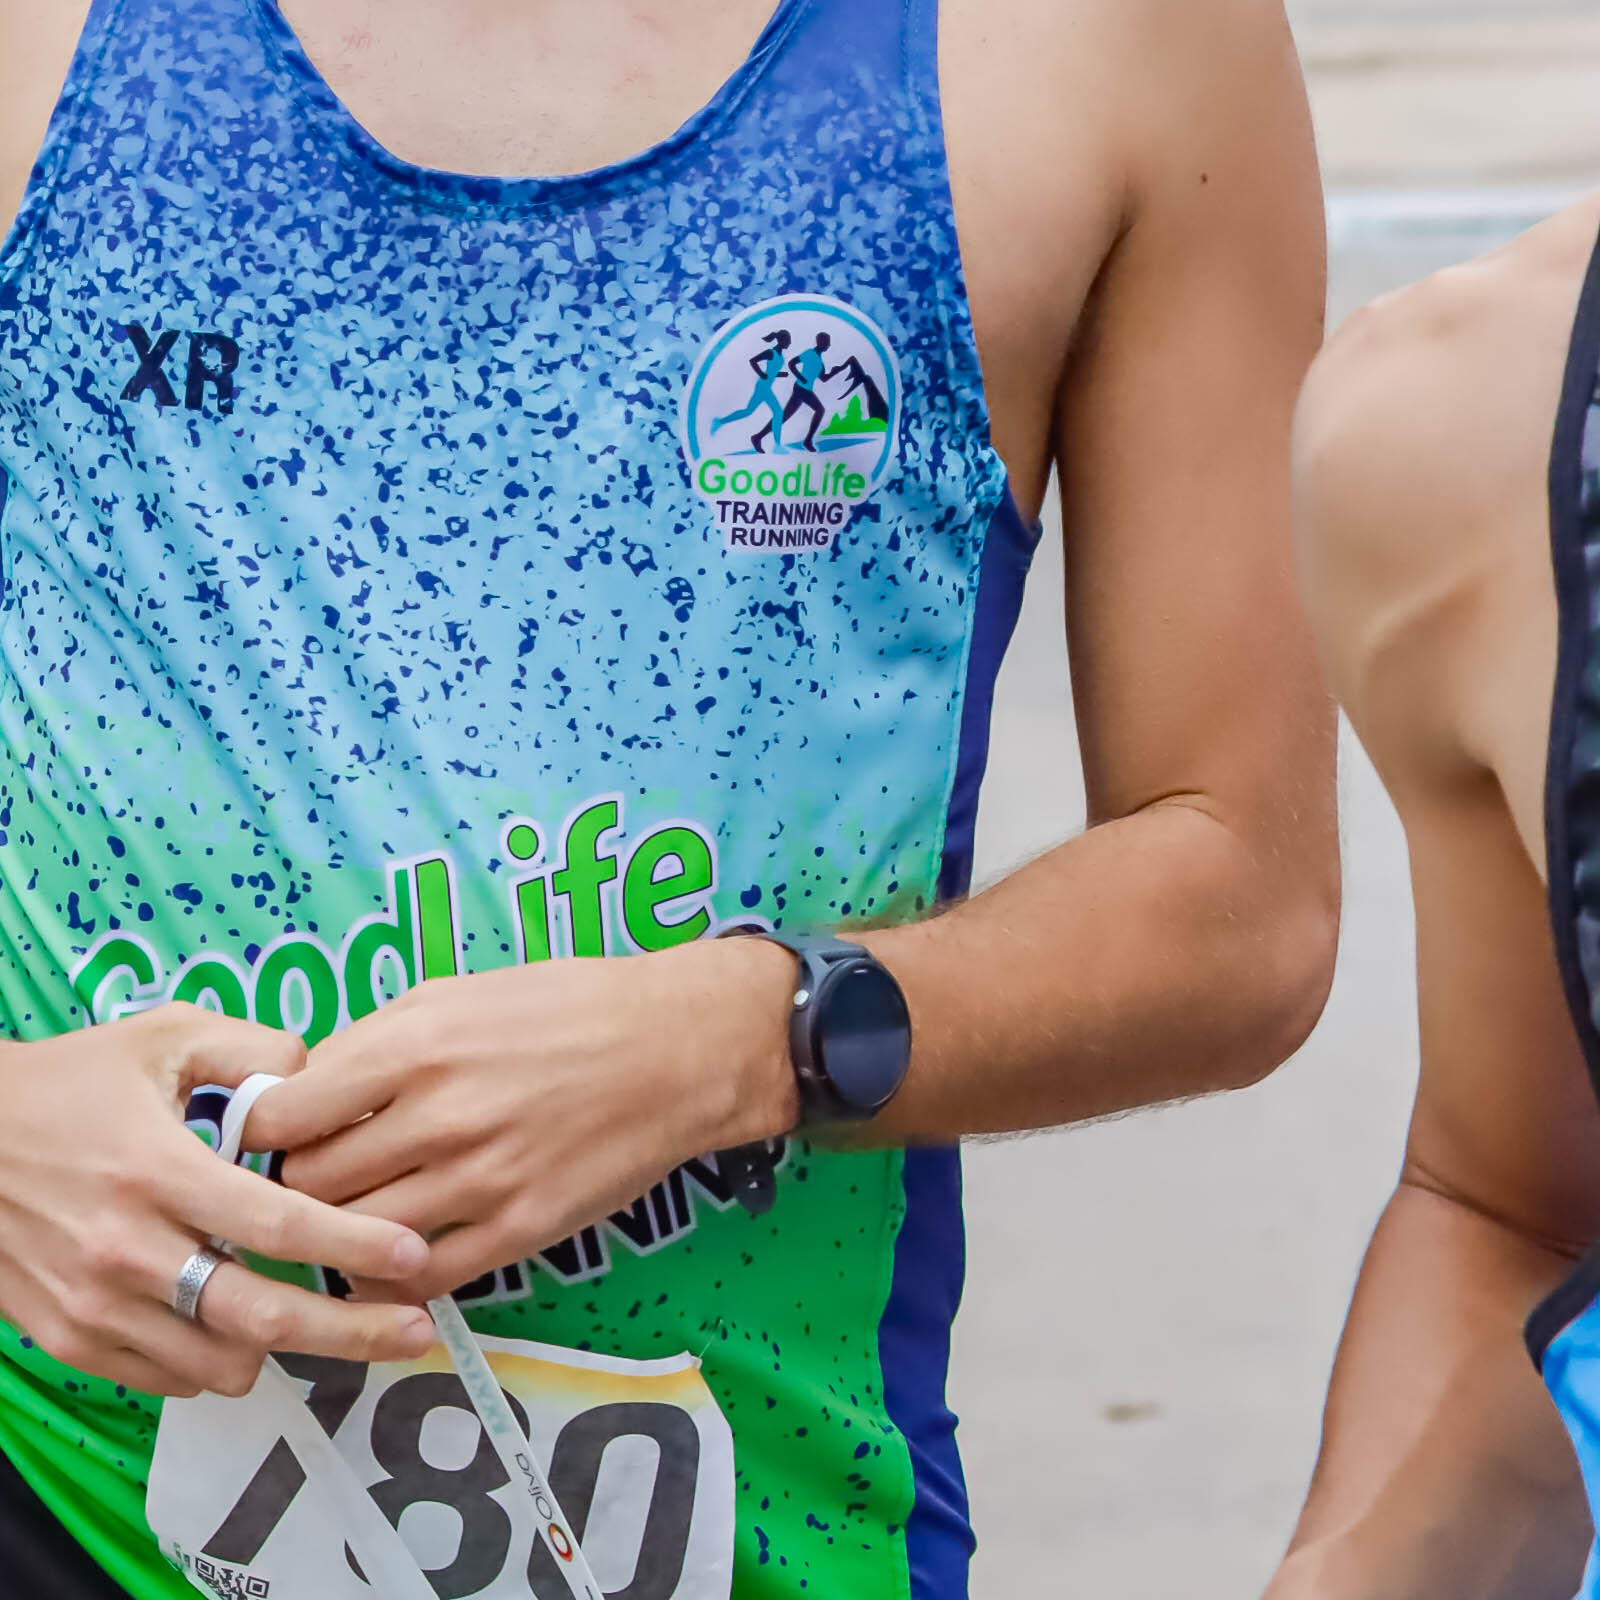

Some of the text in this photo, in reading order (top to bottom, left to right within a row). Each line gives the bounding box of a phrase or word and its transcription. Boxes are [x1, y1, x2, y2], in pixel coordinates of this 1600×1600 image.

[120, 325, 239, 414] XR
[698, 458, 866, 498] GoodLife
[716, 500, 843, 526] TRAINNING
[731, 527, 829, 547] RUNNING
[515, 1452, 553, 1521] Oliva
